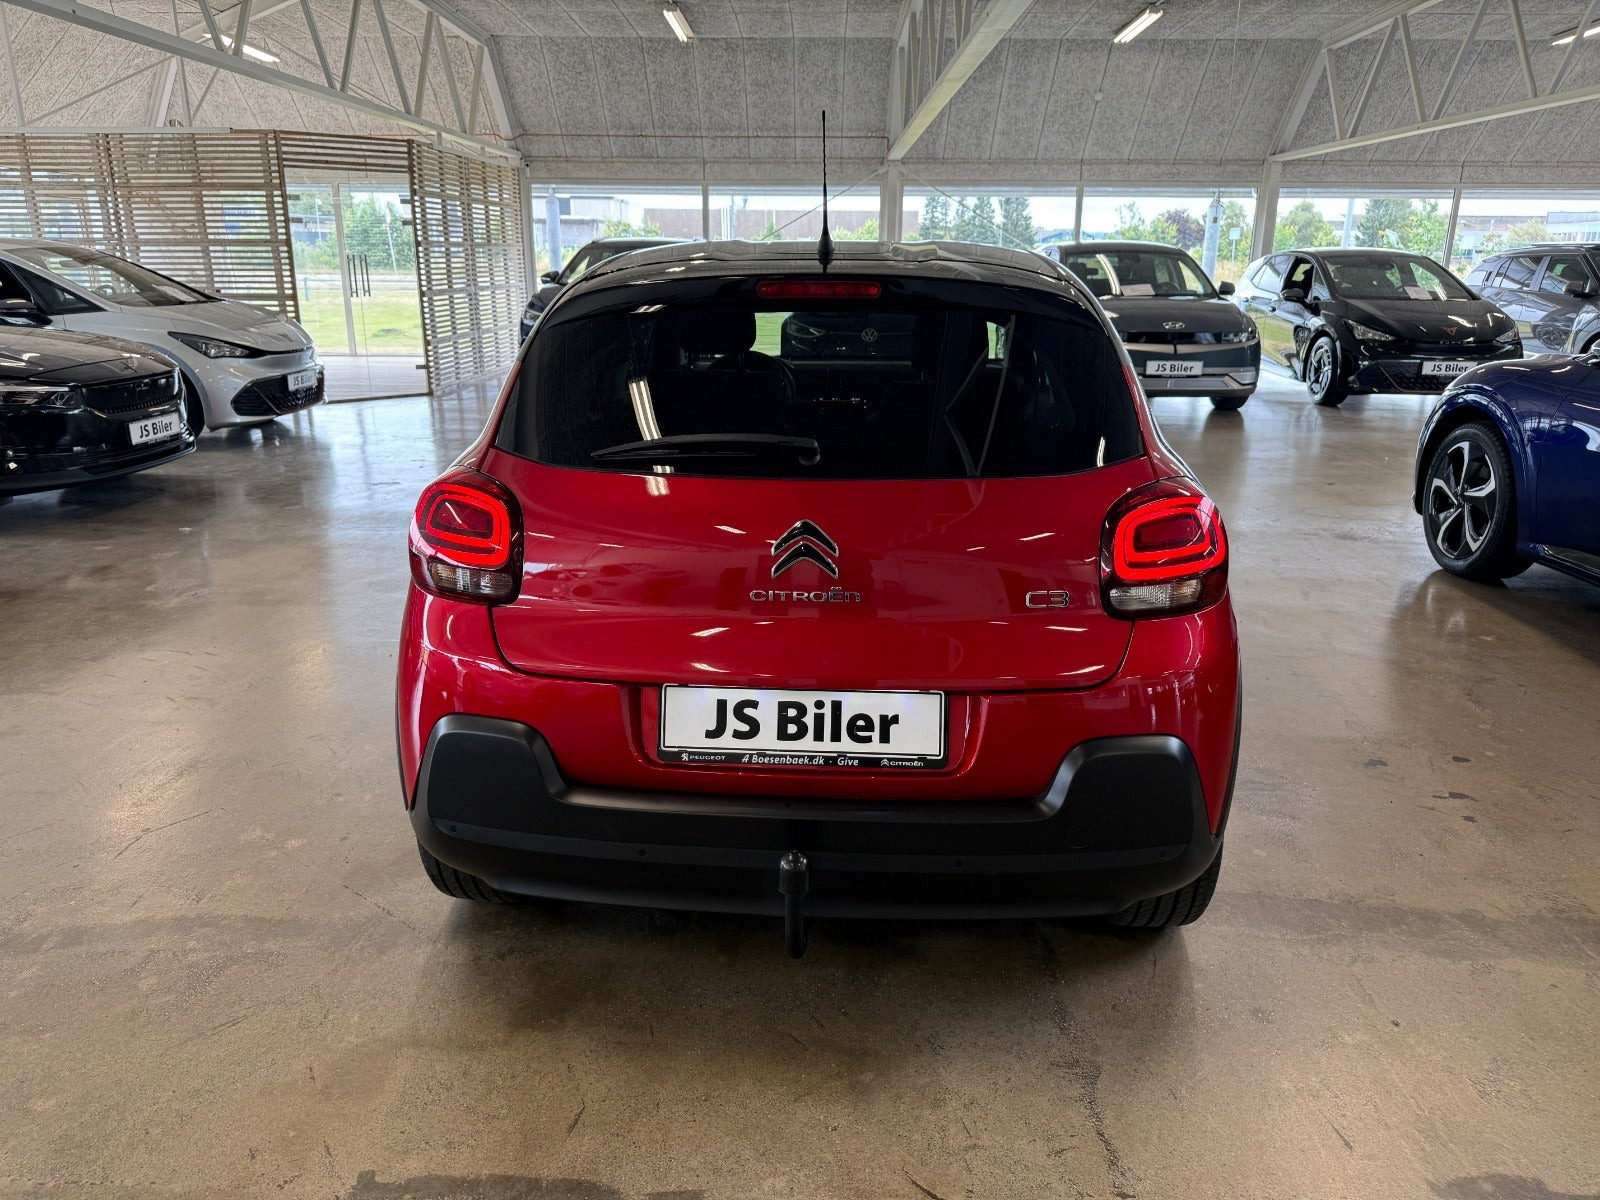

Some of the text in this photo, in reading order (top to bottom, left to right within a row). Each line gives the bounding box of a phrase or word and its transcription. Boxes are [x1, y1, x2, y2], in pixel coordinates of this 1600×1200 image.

[1155, 363, 1194, 373] JS Biler
[1431, 363, 1469, 373] JS Biler
[139, 420, 173, 439] JS Biler
[1025, 590, 1070, 608] C3
[705, 699, 900, 744] JS Biler
[751, 755, 825, 766] Boesenbaek.dk
[837, 757, 859, 766] Give
